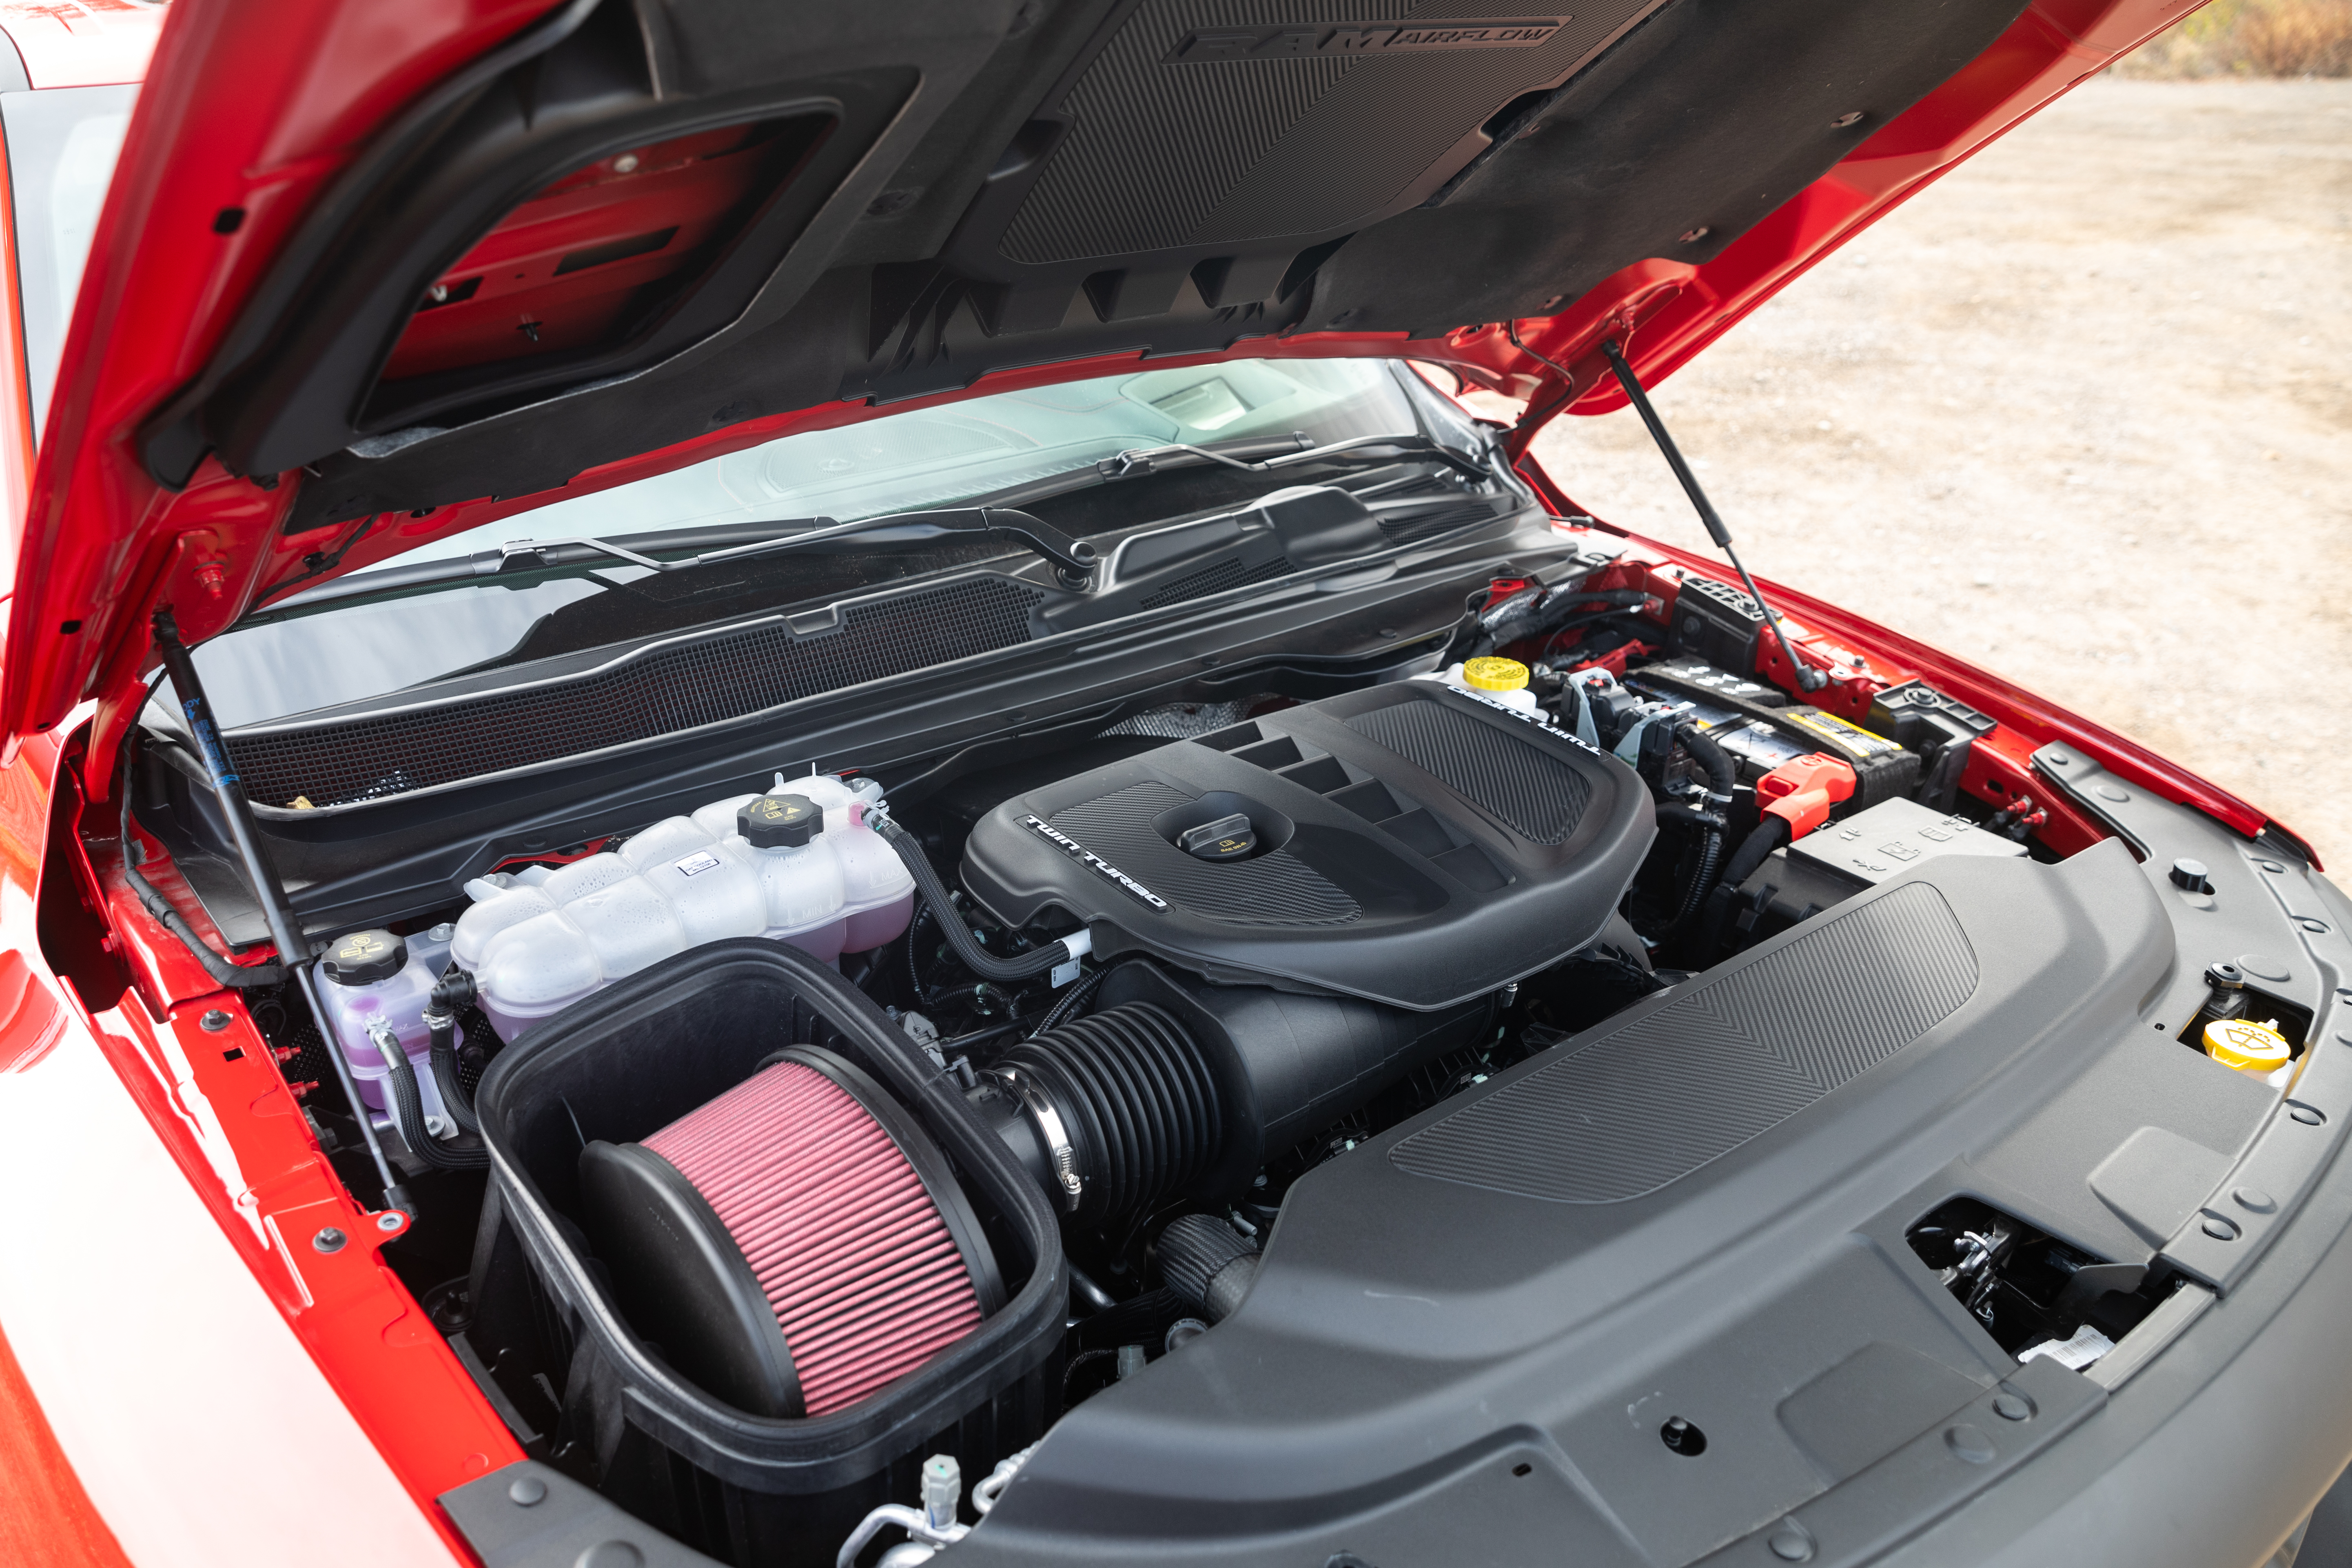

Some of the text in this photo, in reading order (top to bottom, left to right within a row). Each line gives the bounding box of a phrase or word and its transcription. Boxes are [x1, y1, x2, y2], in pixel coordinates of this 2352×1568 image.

[1177, 28, 1554, 57] RAM AIRFLOW
[182, 697, 200, 711] ODY
[1447, 685, 1601, 756] TWIN TURBO
[882, 865, 903, 881] MAX
[1027, 815, 1167, 909] TWIN TURBO
